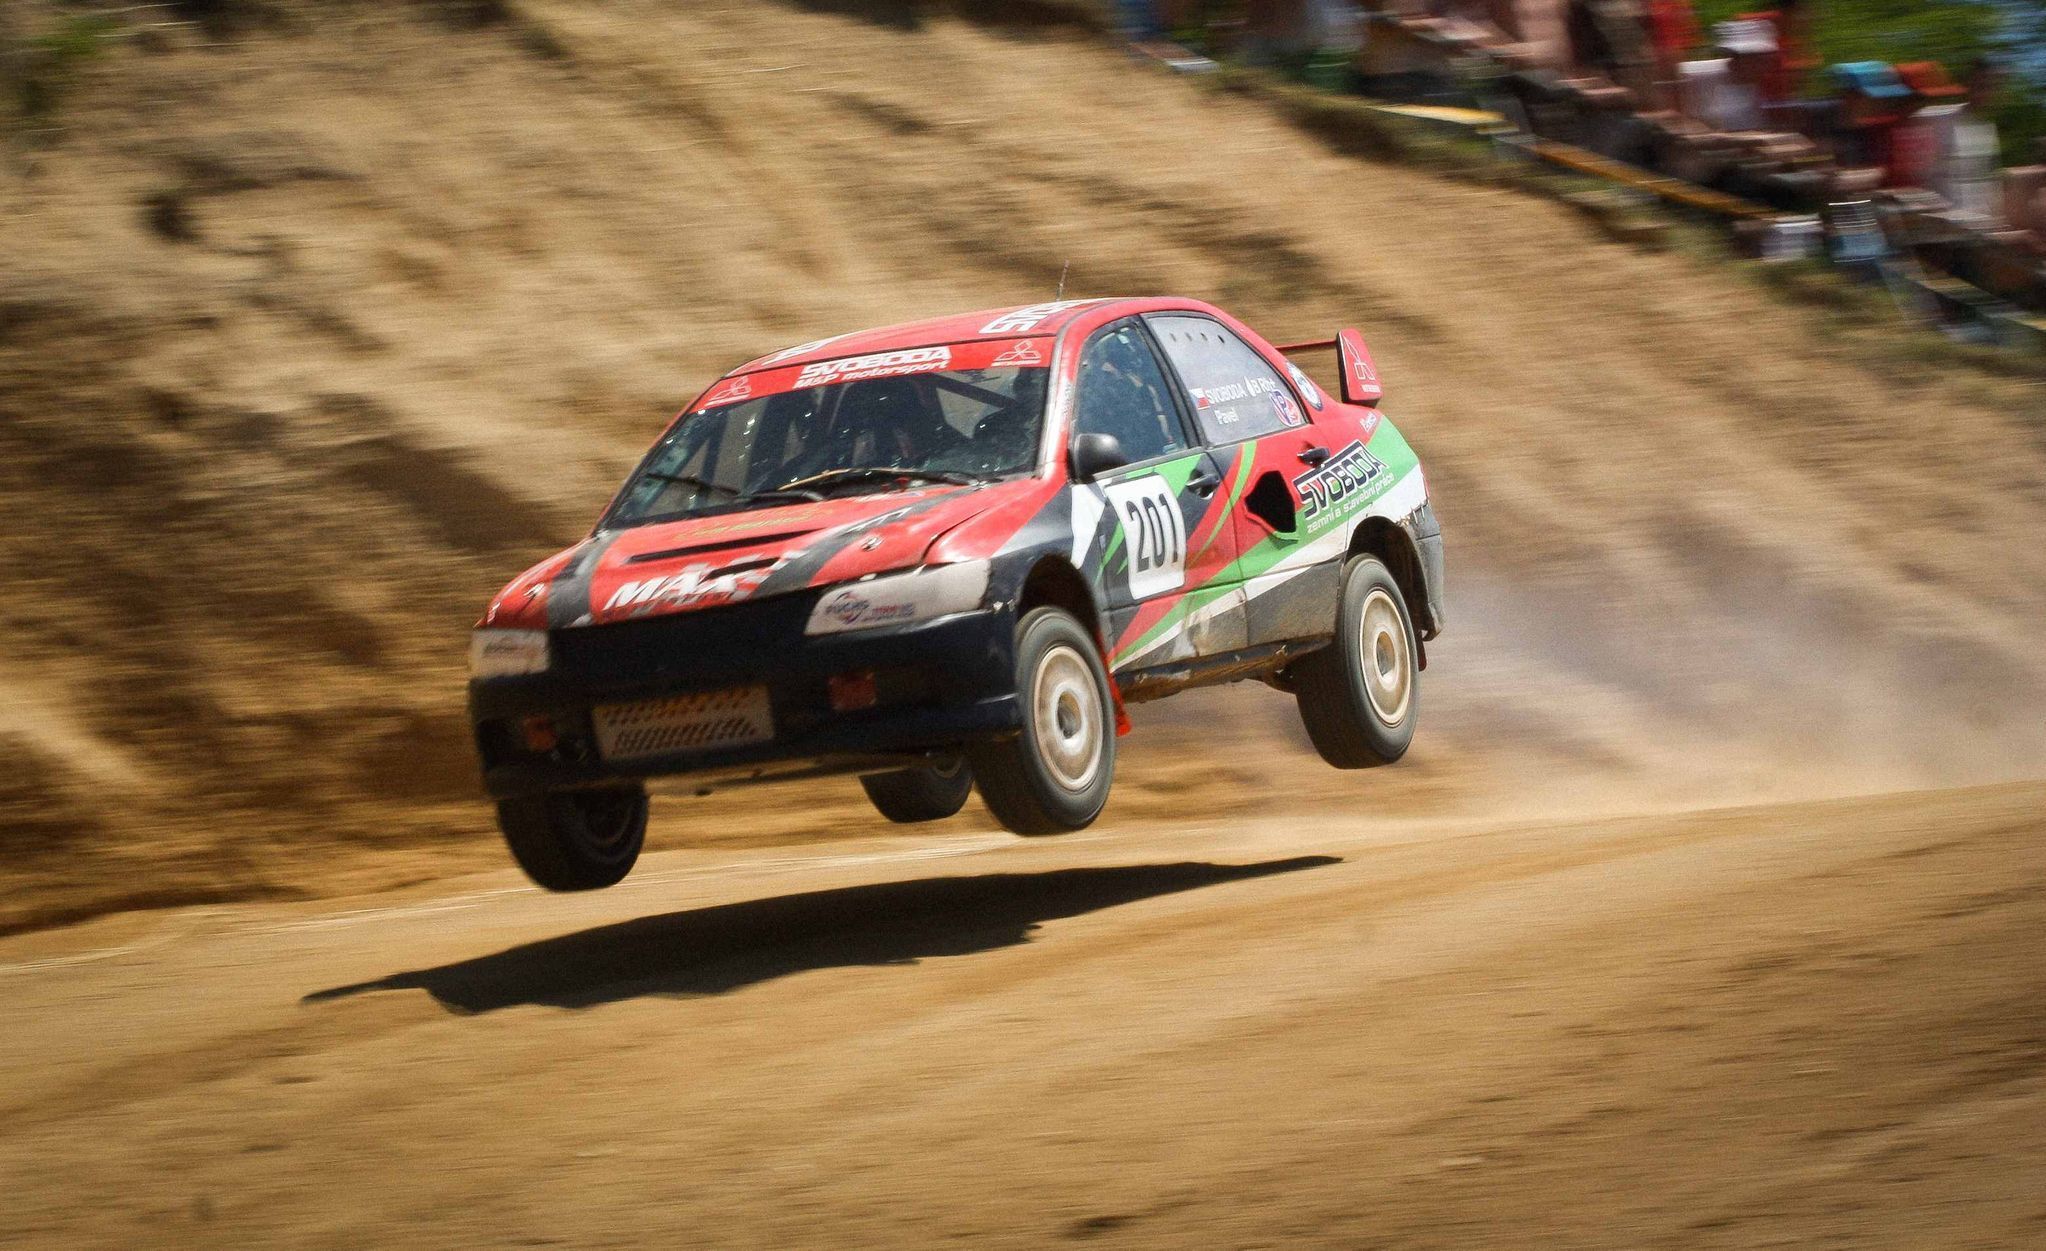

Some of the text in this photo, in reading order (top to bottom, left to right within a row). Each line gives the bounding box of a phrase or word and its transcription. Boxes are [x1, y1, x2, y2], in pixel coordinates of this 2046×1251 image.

[800, 346, 952, 379] SVOBODA
[841, 358, 949, 382] motorsport
[1205, 383, 1248, 404] SVOBODA
[1214, 406, 1240, 425] Pavel
[1292, 440, 1389, 520] SVOBODA
[1126, 493, 1178, 573] 201
